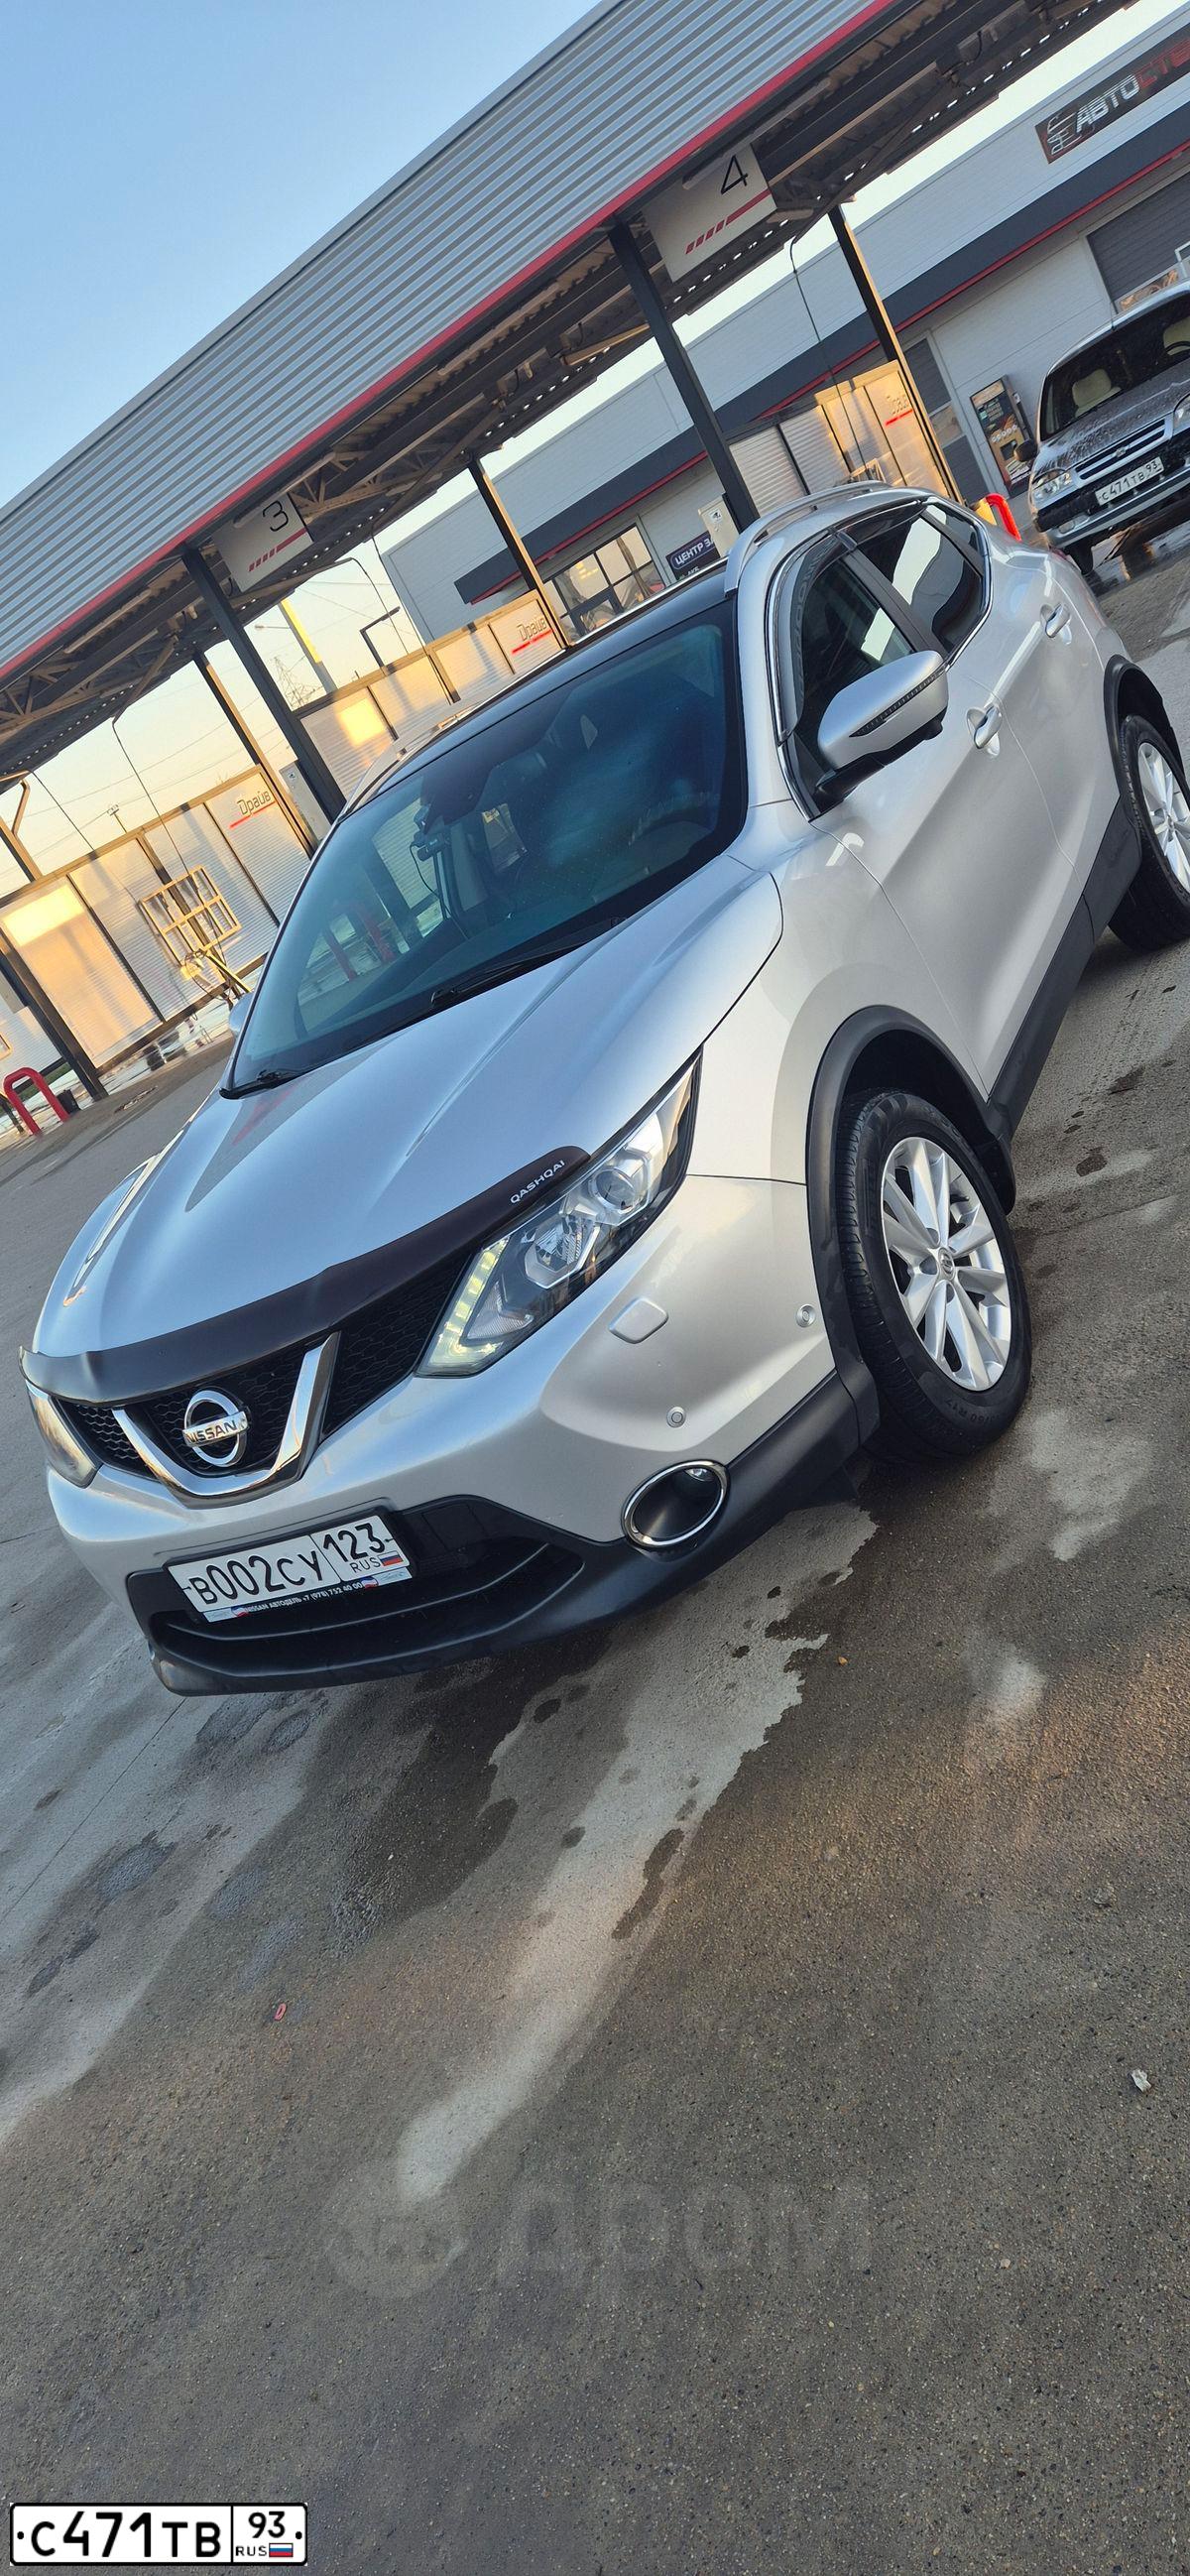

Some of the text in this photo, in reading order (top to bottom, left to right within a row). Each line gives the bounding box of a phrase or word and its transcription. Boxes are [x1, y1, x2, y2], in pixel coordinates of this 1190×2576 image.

[720, 154, 749, 194] 4
[262, 500, 289, 532] 3
[674, 542, 704, 565] ЦЕНТР
[237, 791, 271, 815] Драйв
[510, 1160, 565, 1203] QASHQAI
[185, 1419, 238, 1443] NISSAN
[188, 1523, 386, 1605] В002СУ 123
[349, 1556, 381, 1573] RUS
